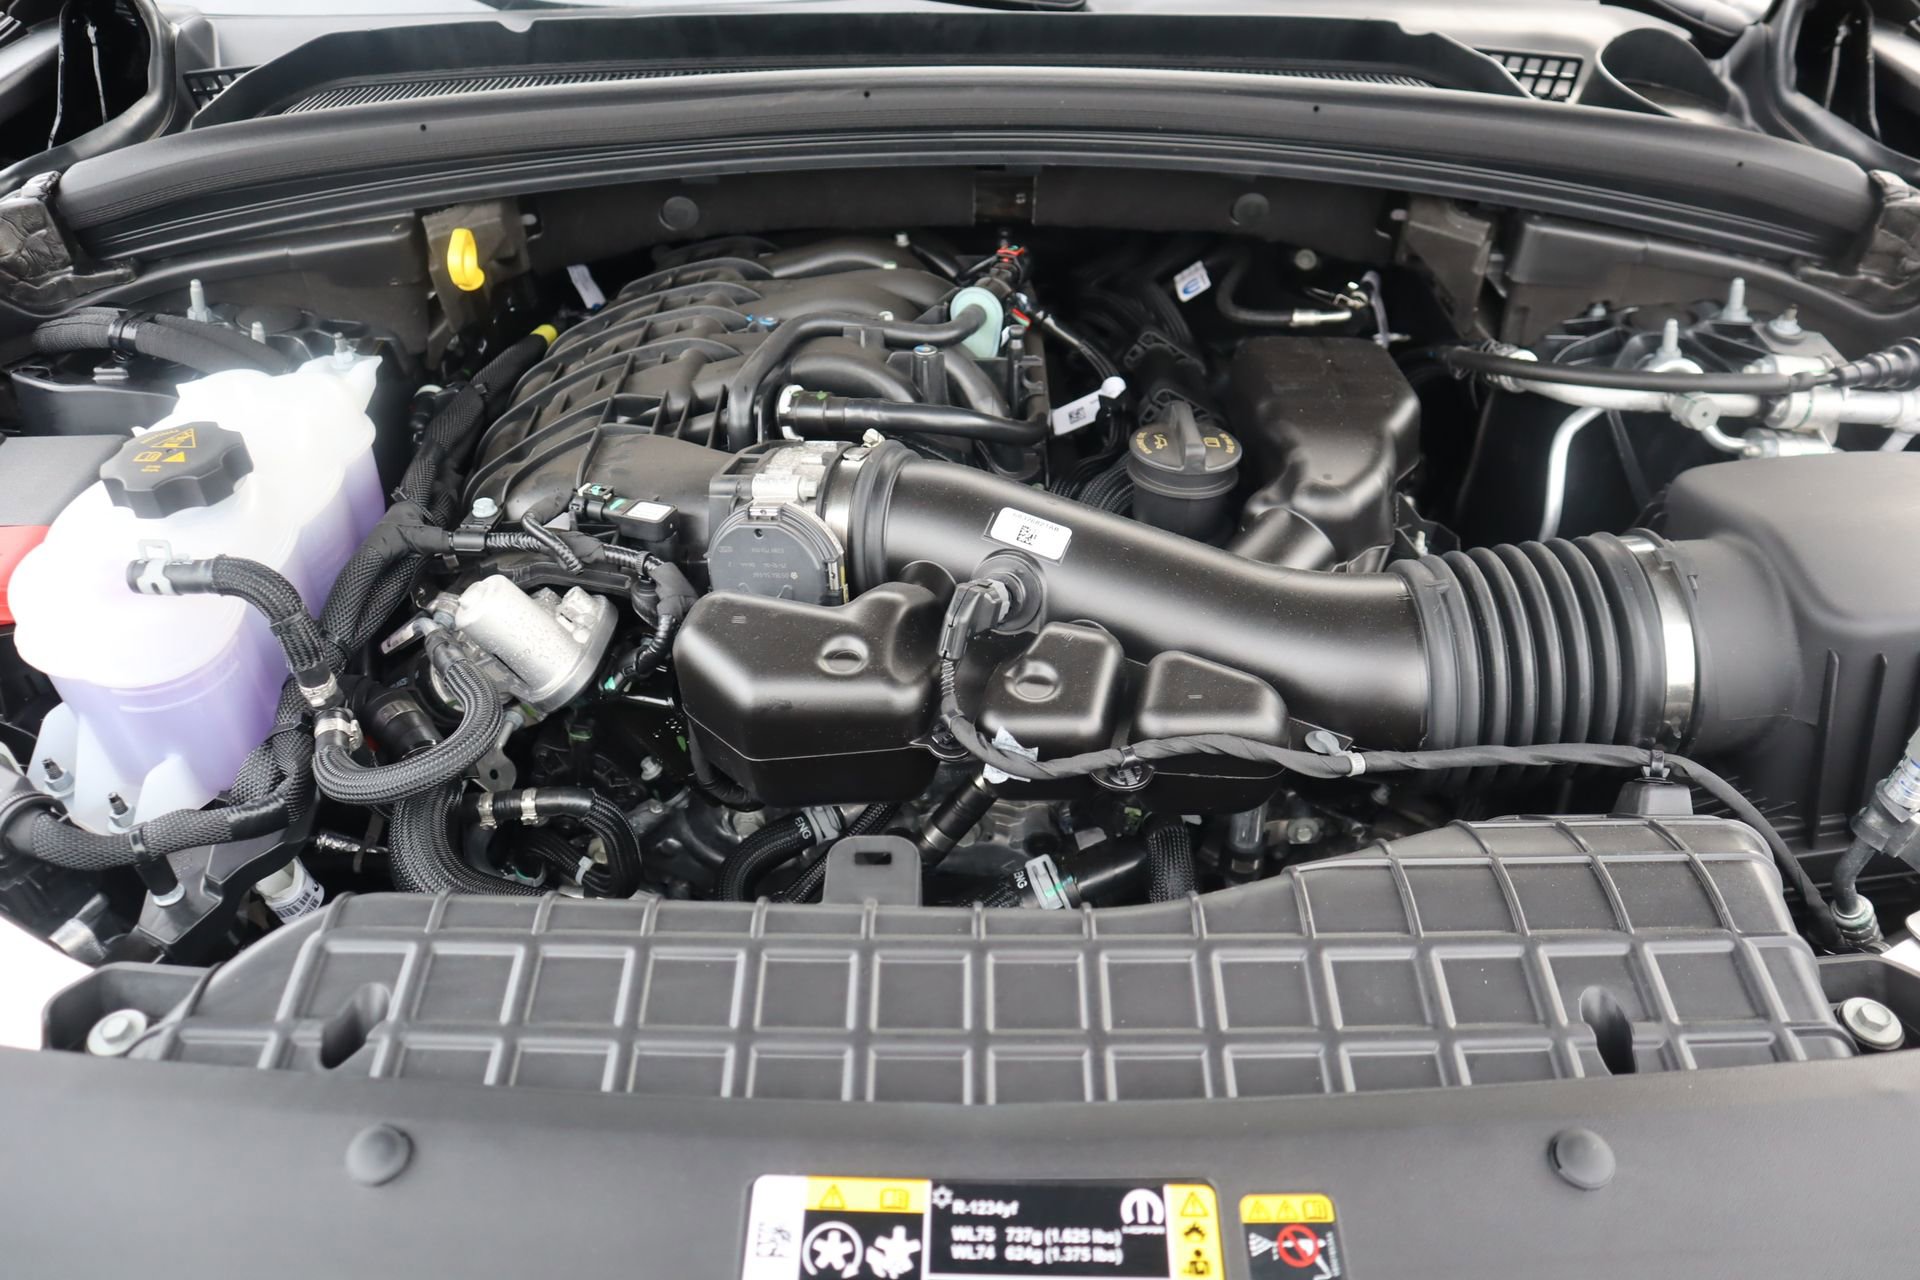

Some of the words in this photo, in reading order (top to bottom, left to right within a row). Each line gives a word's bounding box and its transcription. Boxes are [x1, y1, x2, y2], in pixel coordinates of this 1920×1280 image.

[794, 816, 812, 840] ENG
[1013, 870, 1028, 889] ENG
[952, 1199, 1019, 1219] R-1234yf
[950, 1225, 996, 1242] WL75
[1005, 1227, 1043, 1246] 737g
[1092, 1229, 1122, 1247] lbs)
[950, 1244, 996, 1260] WL74
[1004, 1246, 1043, 1264] 624g
[1044, 1246, 1092, 1264] (1.375
[1092, 1246, 1123, 1265] lbs)
